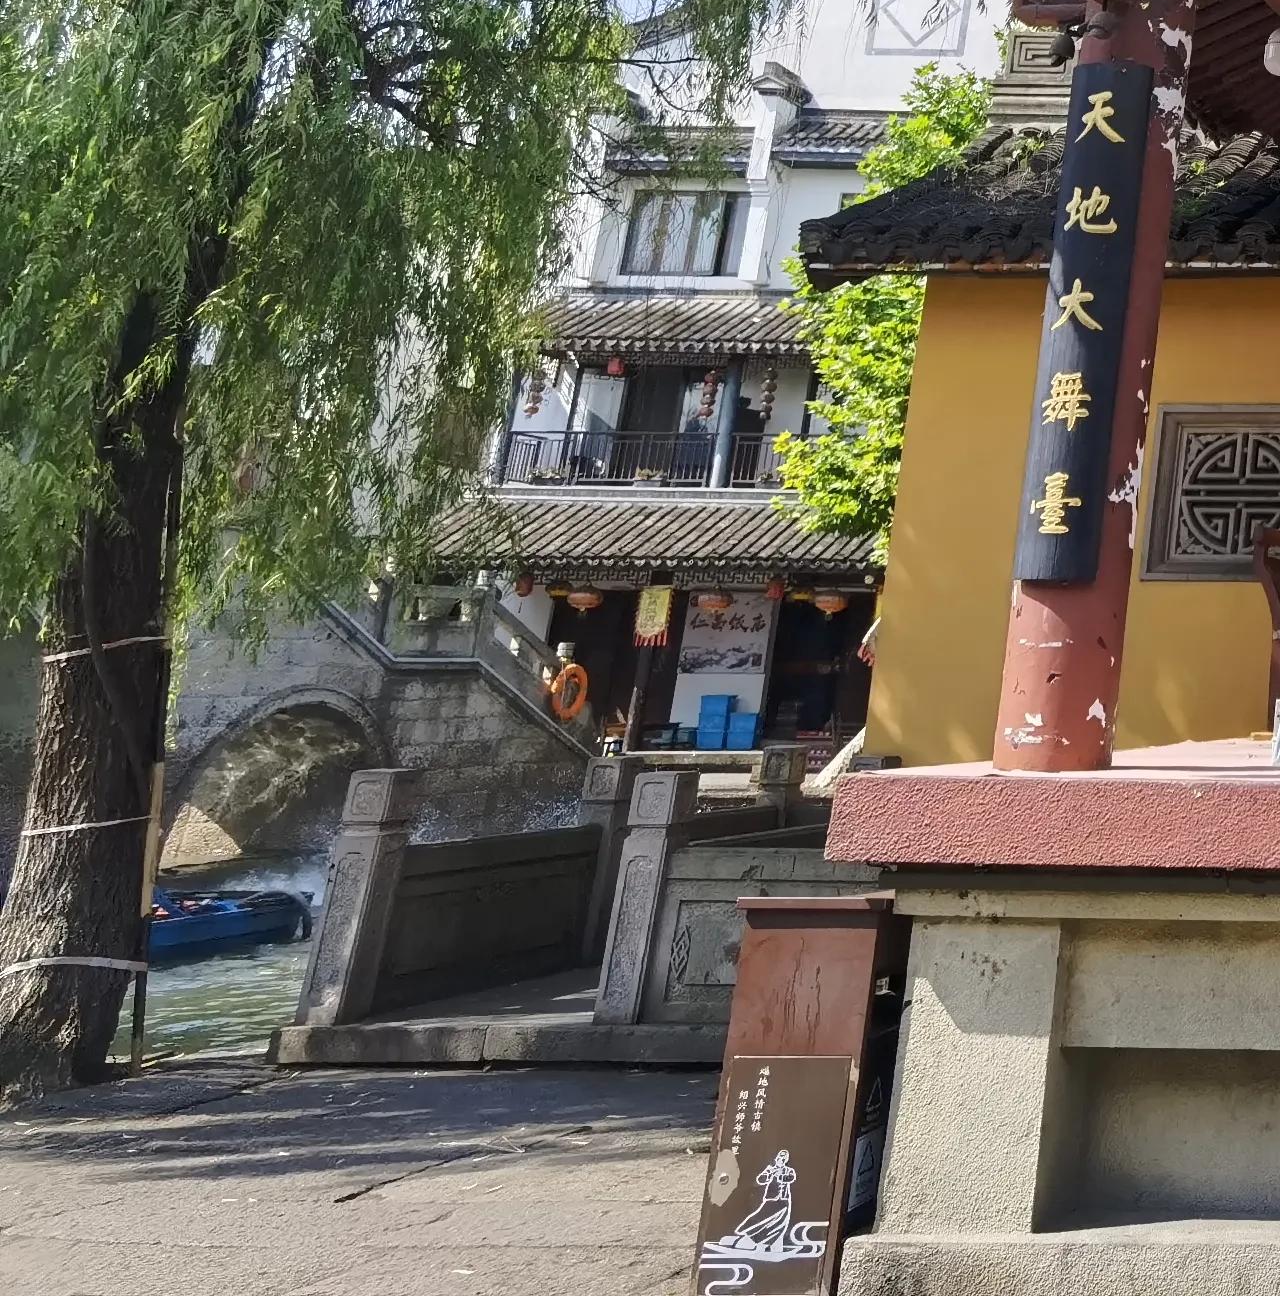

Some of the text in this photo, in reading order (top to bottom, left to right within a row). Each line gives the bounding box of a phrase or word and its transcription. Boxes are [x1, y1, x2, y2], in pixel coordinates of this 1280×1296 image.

[1029, 91, 1126, 534] 天地大舞臺
